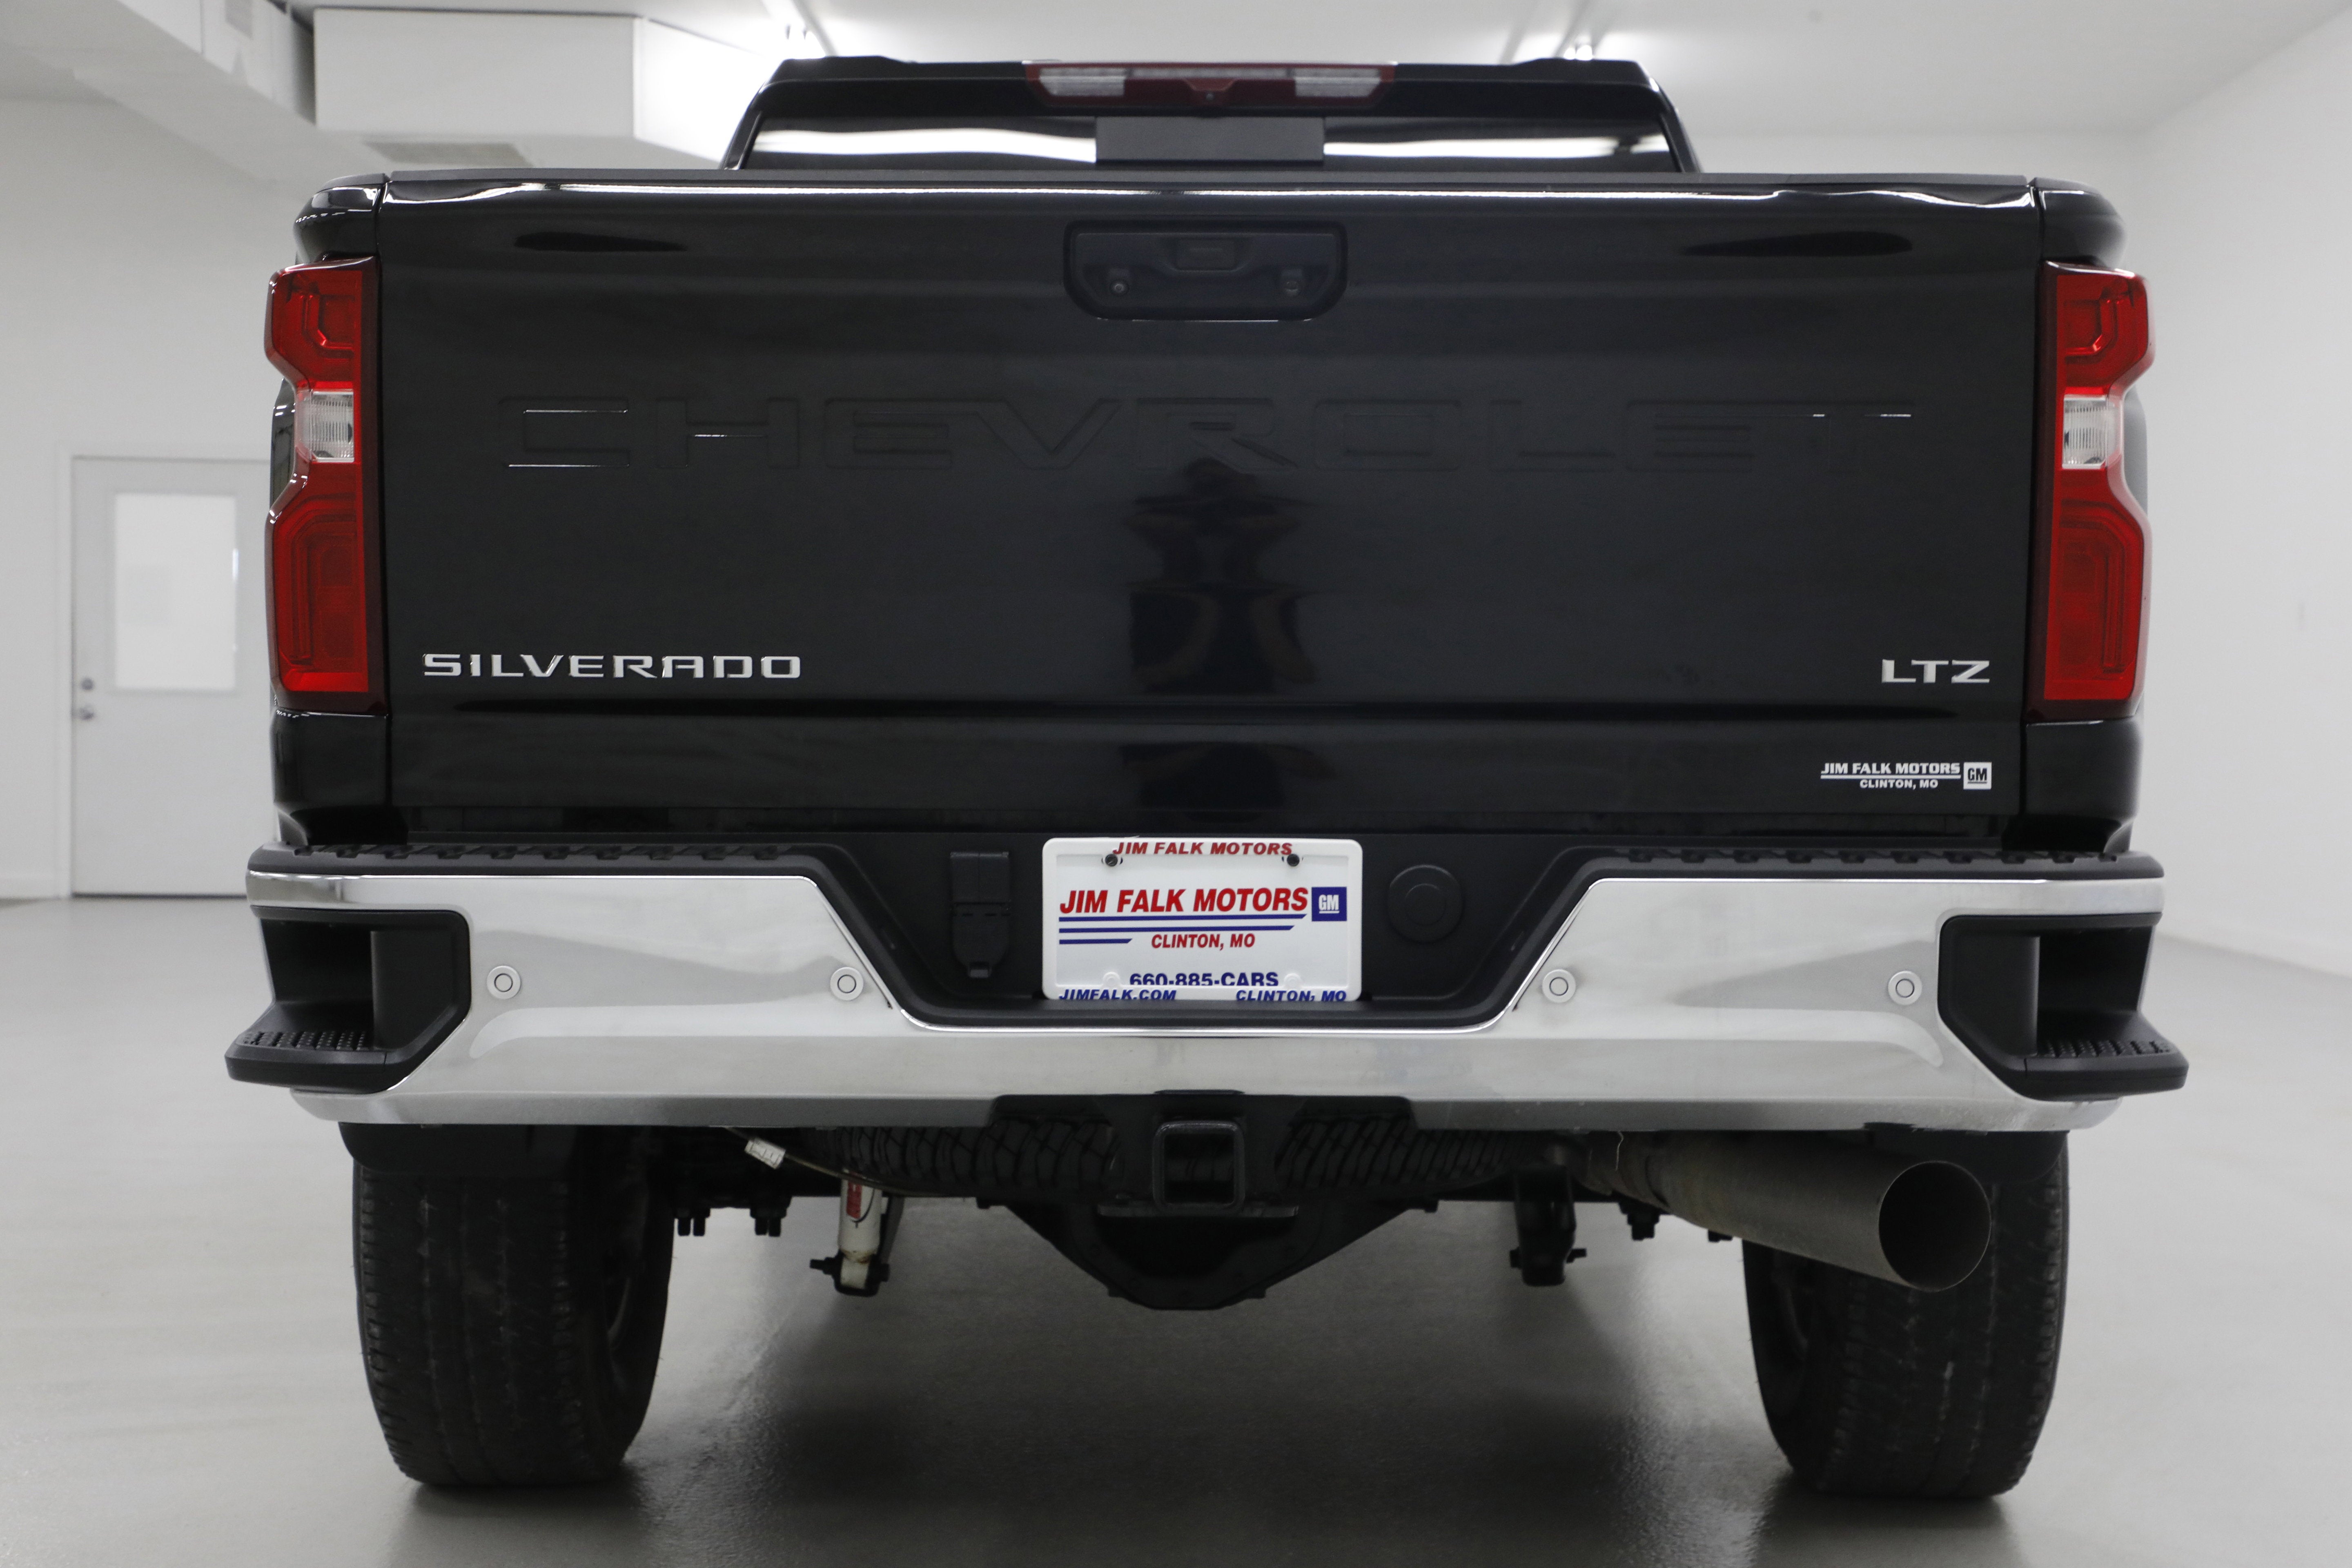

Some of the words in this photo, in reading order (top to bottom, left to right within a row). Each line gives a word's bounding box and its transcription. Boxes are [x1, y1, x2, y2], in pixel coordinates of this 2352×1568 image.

[423, 654, 801, 678] SILVERADO
[1882, 659, 1990, 683] LTZ
[1821, 763, 1849, 774] JIM
[1852, 763, 1891, 774] FALK
[1895, 763, 1960, 774] MOTORS
[1968, 768, 1987, 782] GM
[1860, 780, 1916, 790] CLINTON,
[1920, 780, 1938, 788] MO
[1112, 842, 1148, 854] JIM
[1155, 842, 1205, 854] FALK
[1211, 842, 1292, 855] MOTORS
[1060, 890, 1107, 913] JIM
[1116, 889, 1185, 913] FALK
[1193, 888, 1308, 912] MOTORS
[1319, 894, 1340, 911] GM
[1151, 934, 1225, 951] CLINTON,
[1230, 933, 1256, 948] MO
[1129, 972, 1279, 986] 660-885-CARS
[1059, 990, 1177, 1000] JIMFALK.COM
[1236, 990, 1316, 1001] CLINTON,
[1321, 990, 1347, 1002] MO
